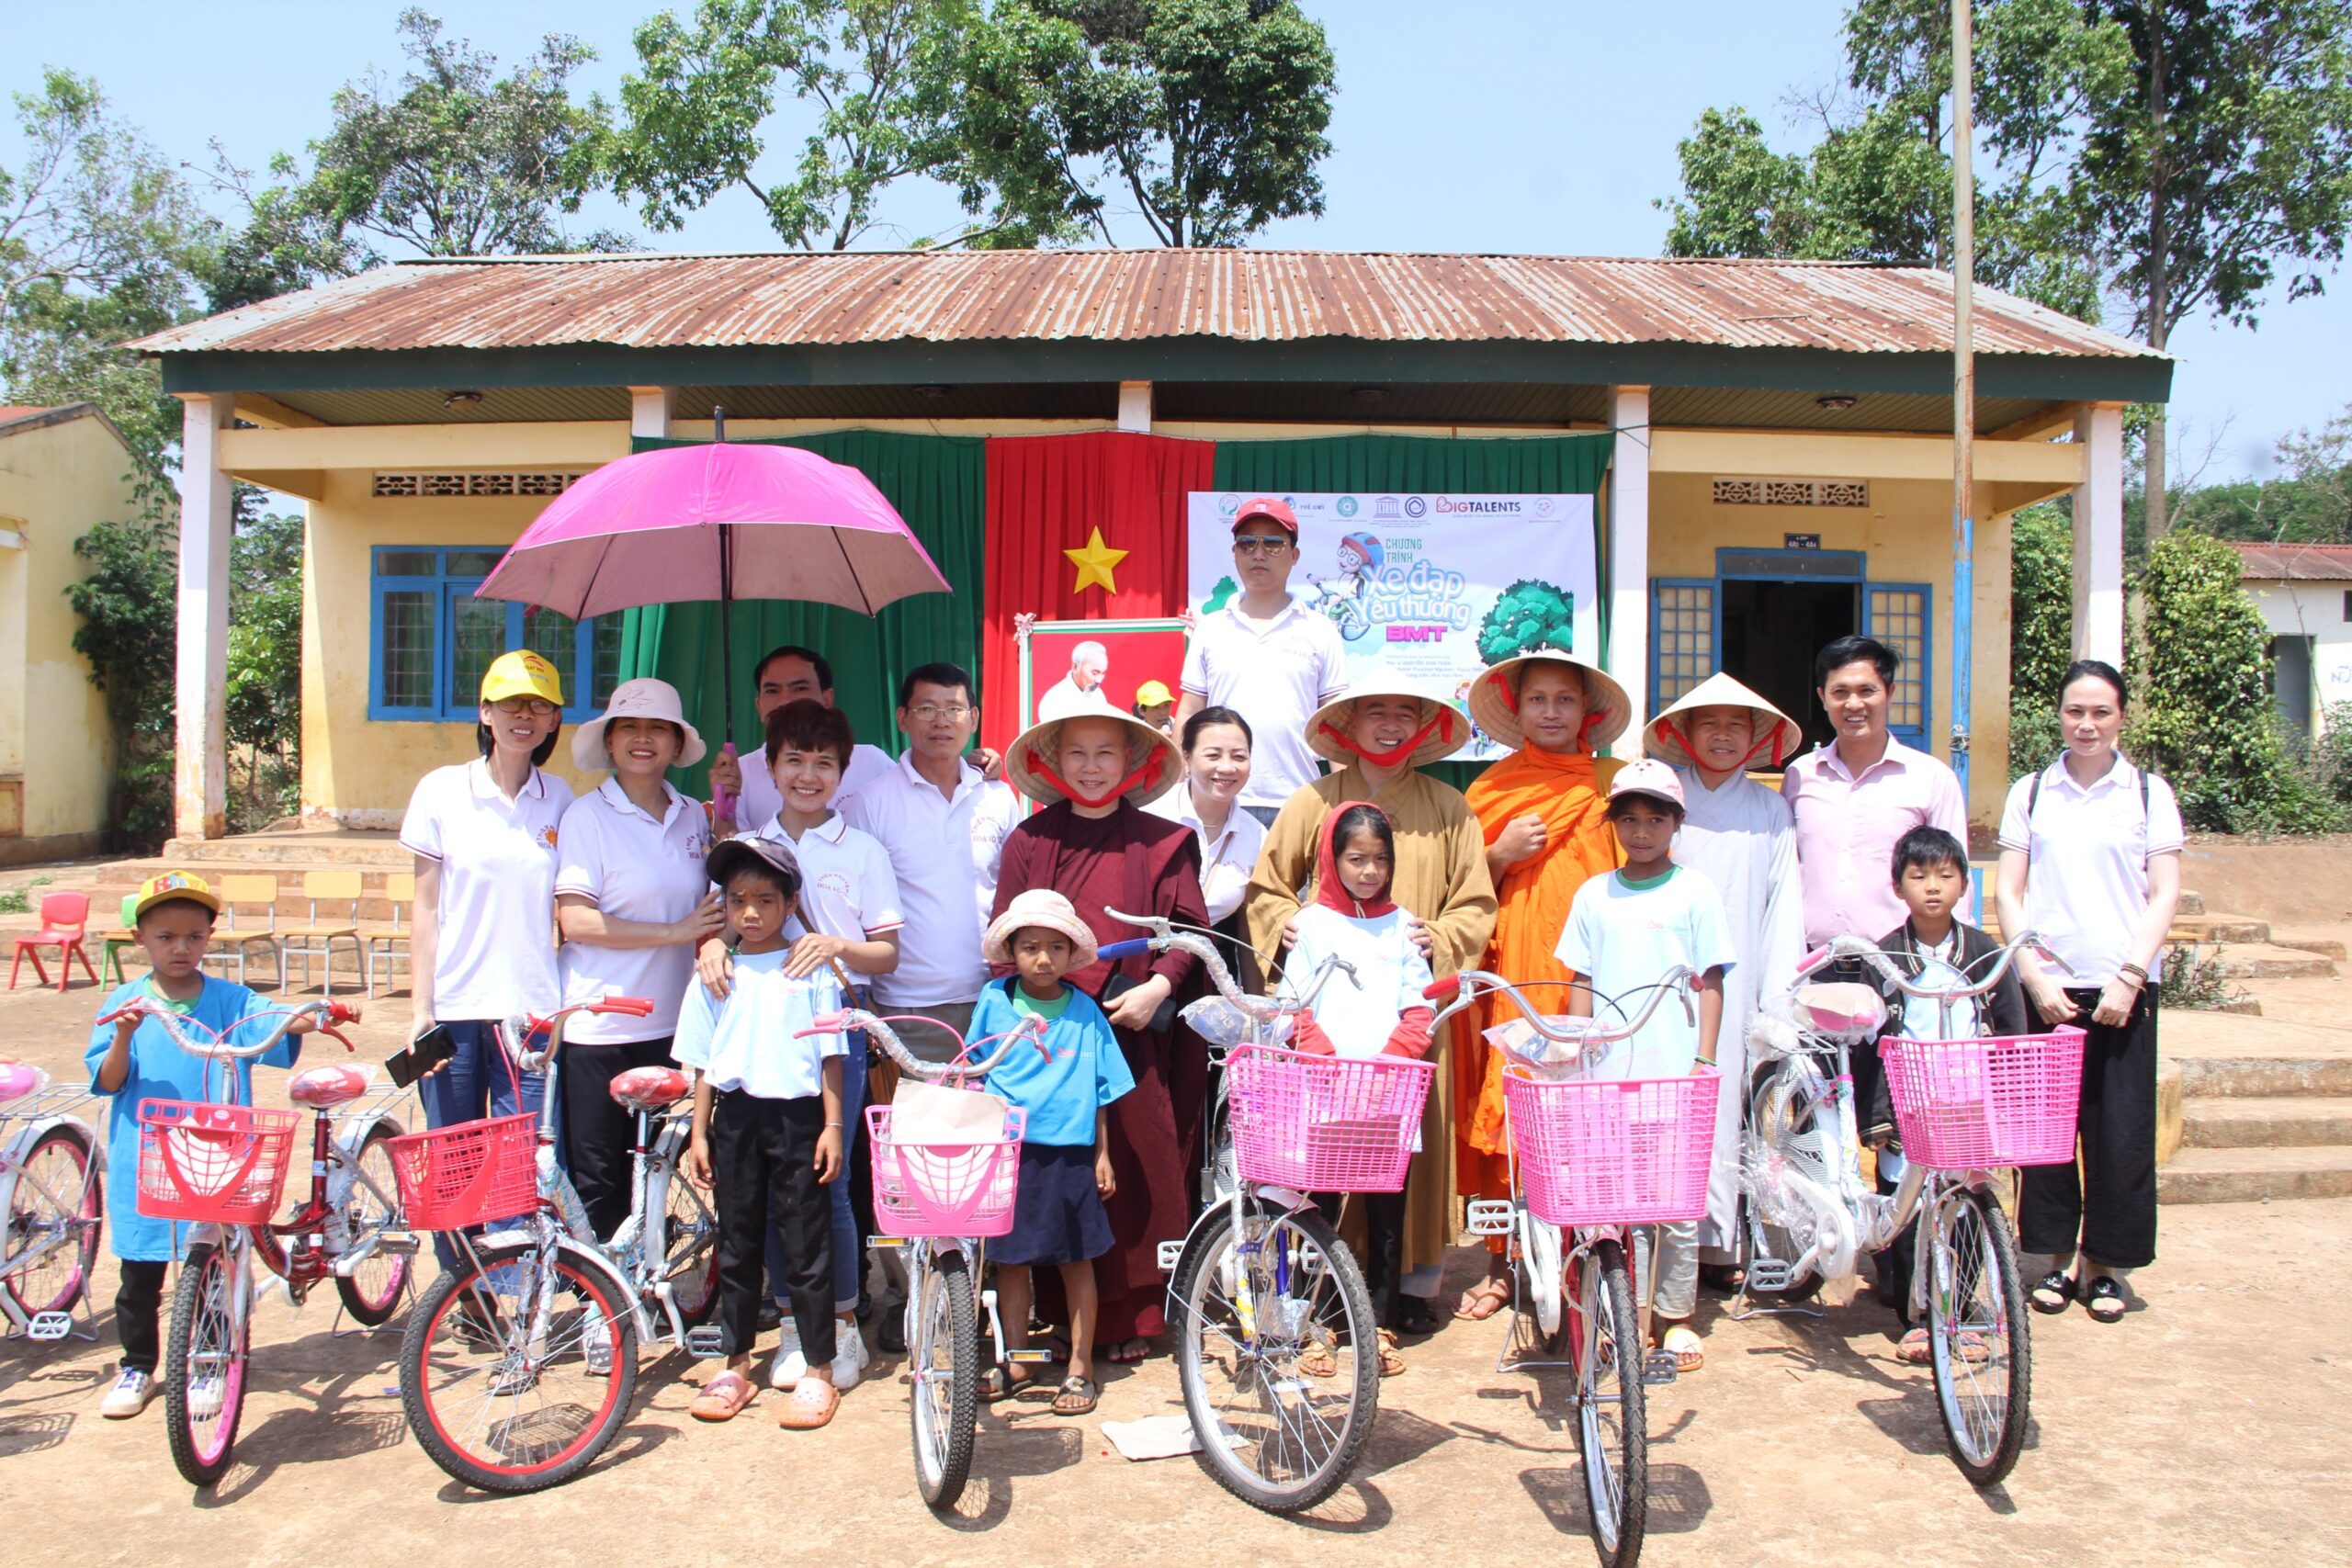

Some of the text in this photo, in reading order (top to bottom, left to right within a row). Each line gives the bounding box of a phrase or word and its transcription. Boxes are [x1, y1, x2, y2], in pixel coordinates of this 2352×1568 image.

[1385, 537, 1422, 549] CHƯƠNG
[1386, 550, 1413, 563] TRÌNH
[1362, 559, 1465, 600] Xe đạp
[1350, 595, 1397, 626] Yêu
[1385, 626, 1448, 642] BMT
